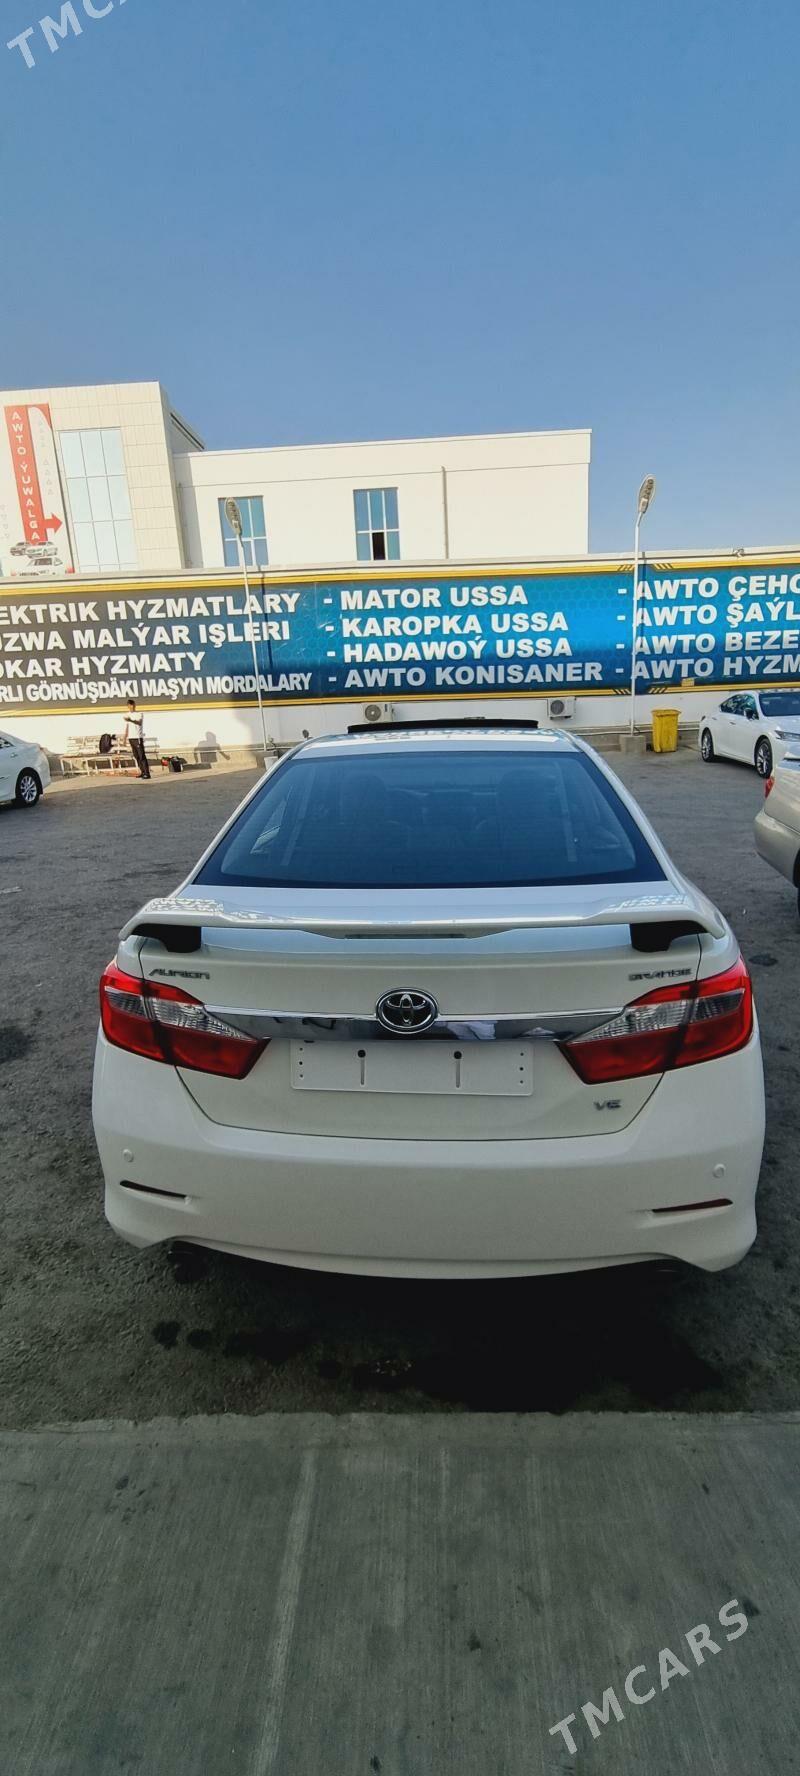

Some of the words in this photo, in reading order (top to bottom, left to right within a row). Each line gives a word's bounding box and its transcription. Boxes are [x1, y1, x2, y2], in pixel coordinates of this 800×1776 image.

[12, 411, 26, 456] AWTO
[341, 588, 442, 610] MATOR
[450, 585, 528, 607] USSA
[636, 577, 719, 600] AWTO
[107, 593, 300, 620] HYZMATLARY
[635, 604, 718, 627] AWTO
[0, 631, 66, 652] ZWA
[73, 623, 191, 649] MALÝAR
[199, 621, 290, 648] IŞLERI
[342, 615, 483, 637] KAROPKA
[491, 612, 569, 633] USSA
[344, 636, 487, 663] HADAWOÝ
[496, 638, 572, 659] USSA
[634, 633, 716, 656] AWTO
[725, 629, 800, 652] BEZE
[0, 658, 64, 678] KAR
[71, 652, 205, 676] HYZMATY
[344, 667, 426, 688] AWTO
[436, 662, 603, 686] KONISANER
[633, 657, 714, 680] AWTO
[26, 677, 138, 703] GÖRNÜŞDÄKI
[141, 677, 203, 700] MAŞYN
[206, 673, 312, 695] MORDALARY
